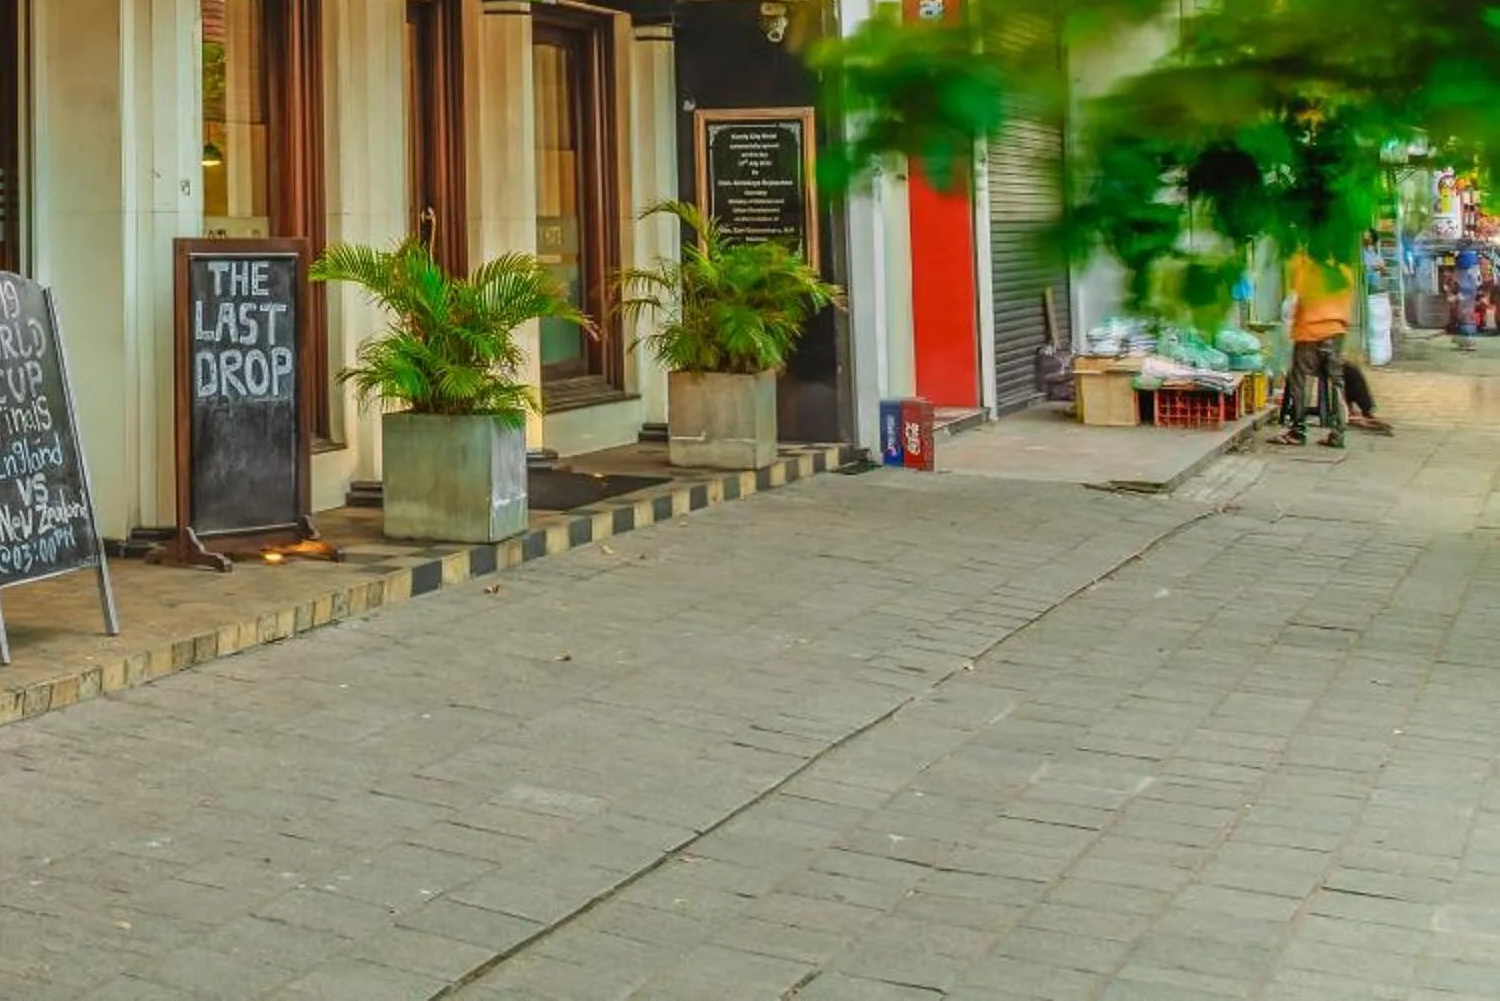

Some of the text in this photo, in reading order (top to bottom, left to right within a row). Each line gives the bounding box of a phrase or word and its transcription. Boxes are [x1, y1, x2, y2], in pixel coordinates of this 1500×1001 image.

[207, 260, 270, 297] THE
[195, 300, 288, 345] LAST
[196, 346, 294, 398] DROP
